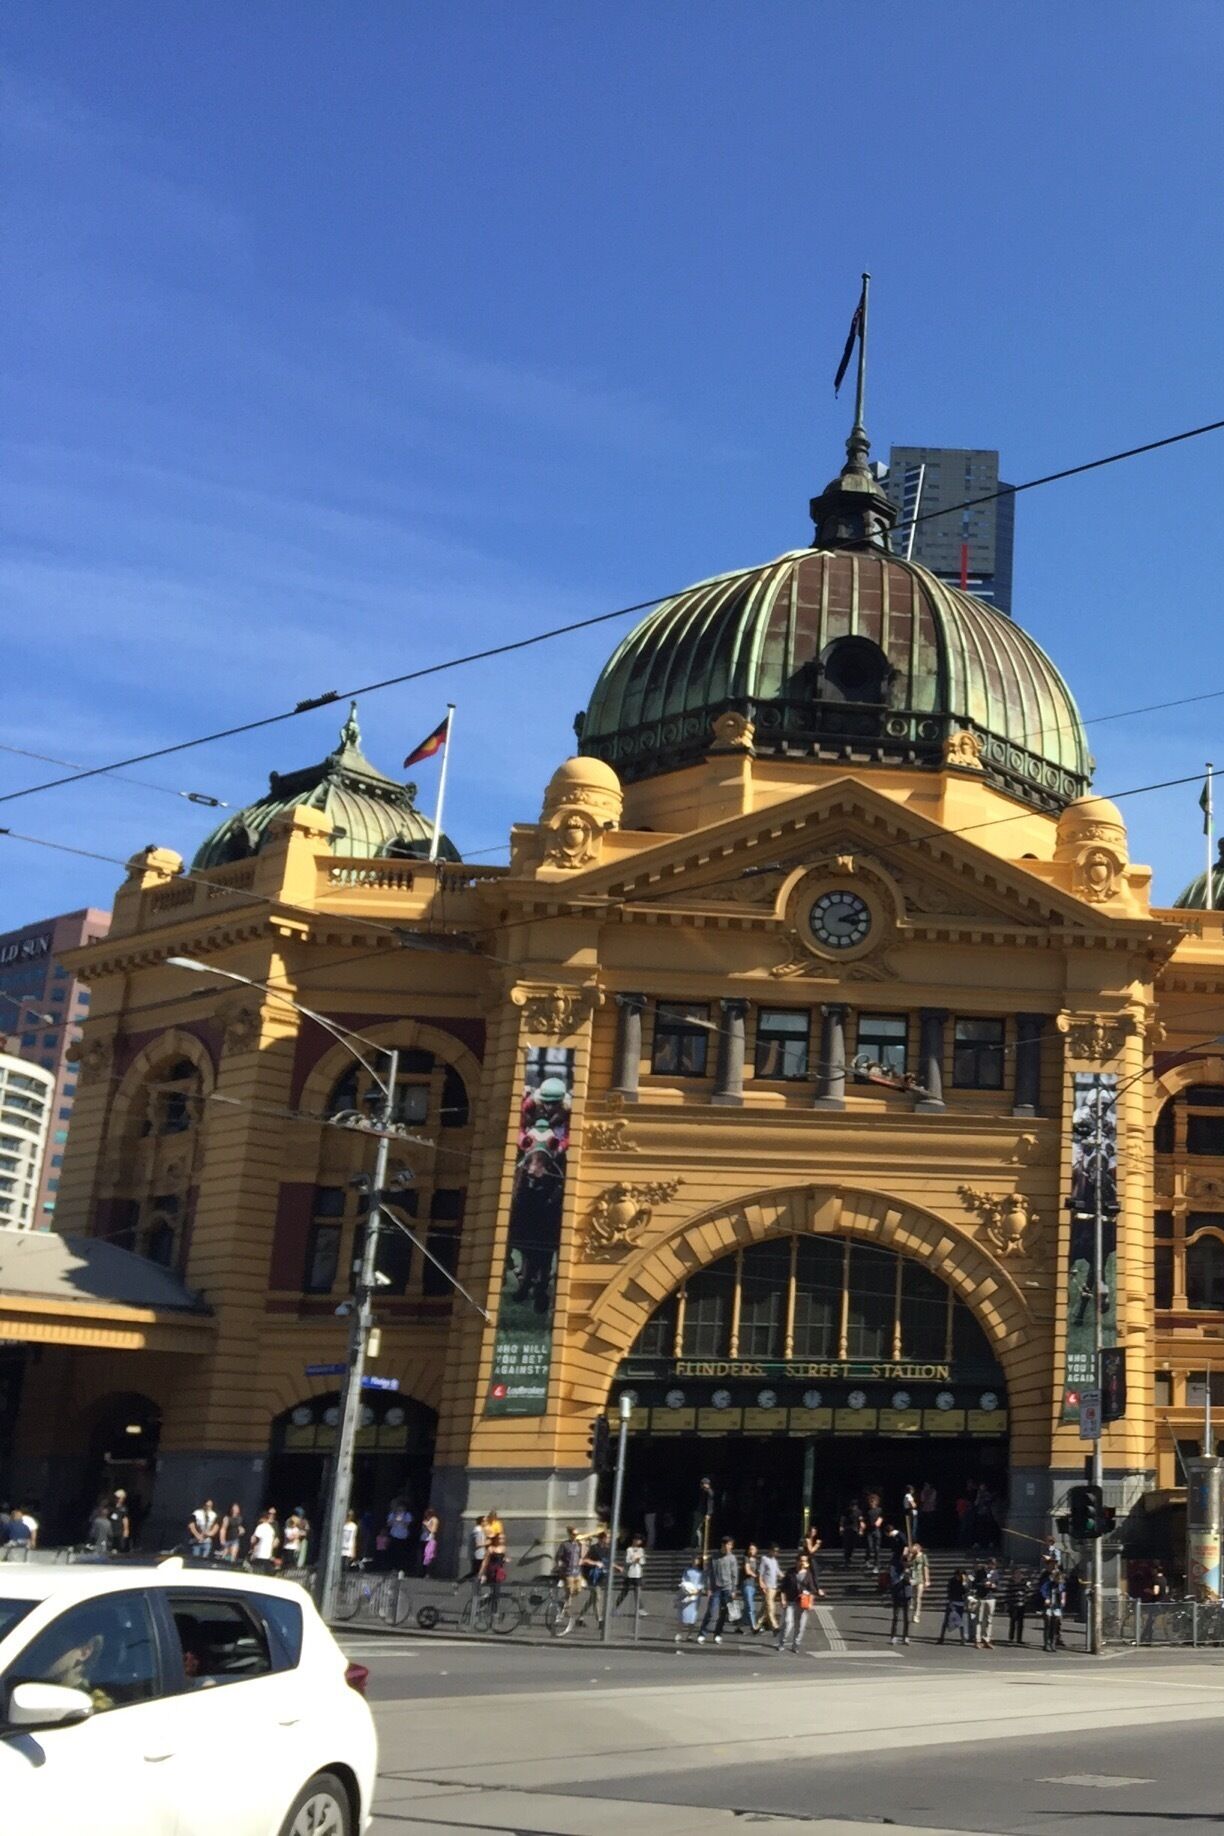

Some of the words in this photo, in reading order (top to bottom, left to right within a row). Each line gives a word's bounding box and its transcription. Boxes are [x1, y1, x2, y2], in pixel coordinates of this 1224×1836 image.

[21, 935, 50, 958] SUN
[496, 1344, 518, 1354] WHO
[523, 1344, 548, 1354] WILL
[496, 1354, 517, 1364] YOU
[522, 1354, 544, 1364] BET
[1067, 1354, 1087, 1363] WHO
[494, 1365, 549, 1375] AGAINST?
[675, 1361, 763, 1377] FLINDERS
[785, 1363, 849, 1378] STREET
[872, 1363, 950, 1379] STATION
[1067, 1363, 1087, 1373] YOU
